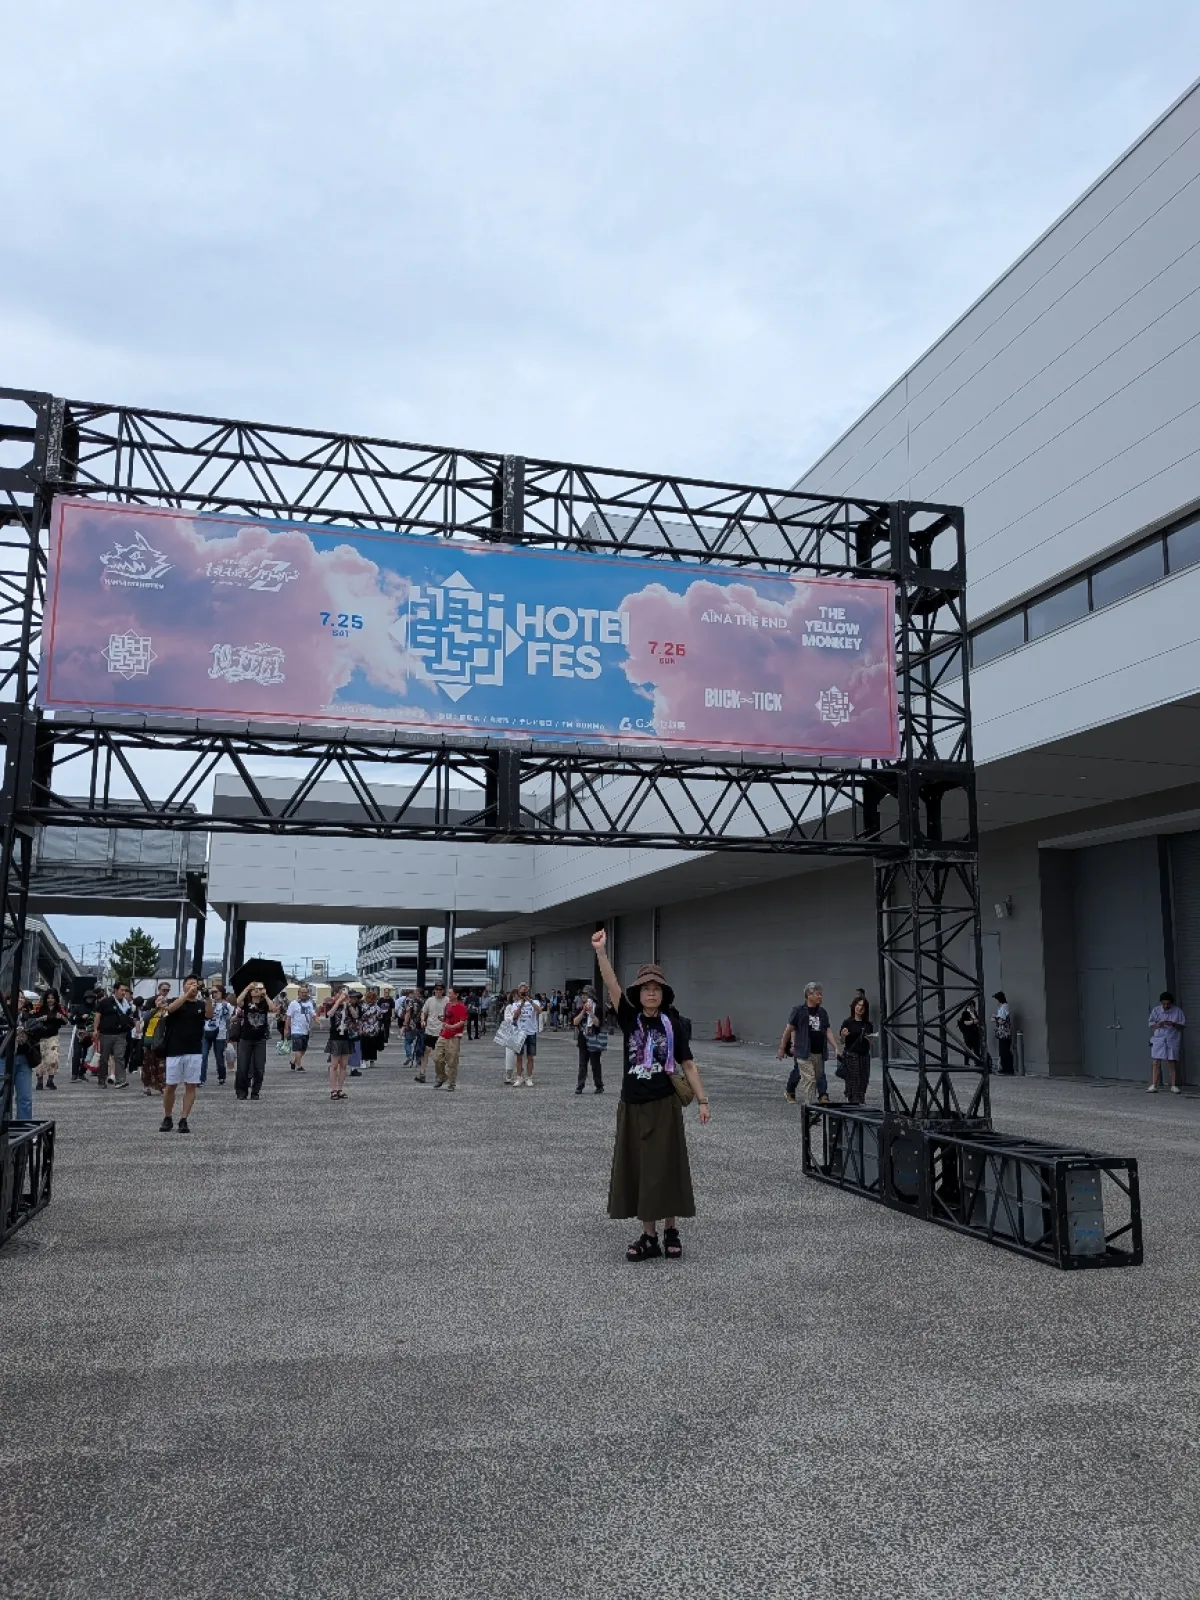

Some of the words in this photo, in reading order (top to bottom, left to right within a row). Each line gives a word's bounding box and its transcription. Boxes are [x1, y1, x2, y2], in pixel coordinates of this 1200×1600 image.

[319, 611, 363, 630] 7.25
[735, 613, 759, 629] THE
[818, 606, 846, 620] THE
[516, 603, 630, 645] HOTEI
[804, 619, 860, 636] YELLOW
[648, 641, 686, 657] 7.26
[801, 633, 862, 651] MONKEY
[527, 641, 602, 680] FES
